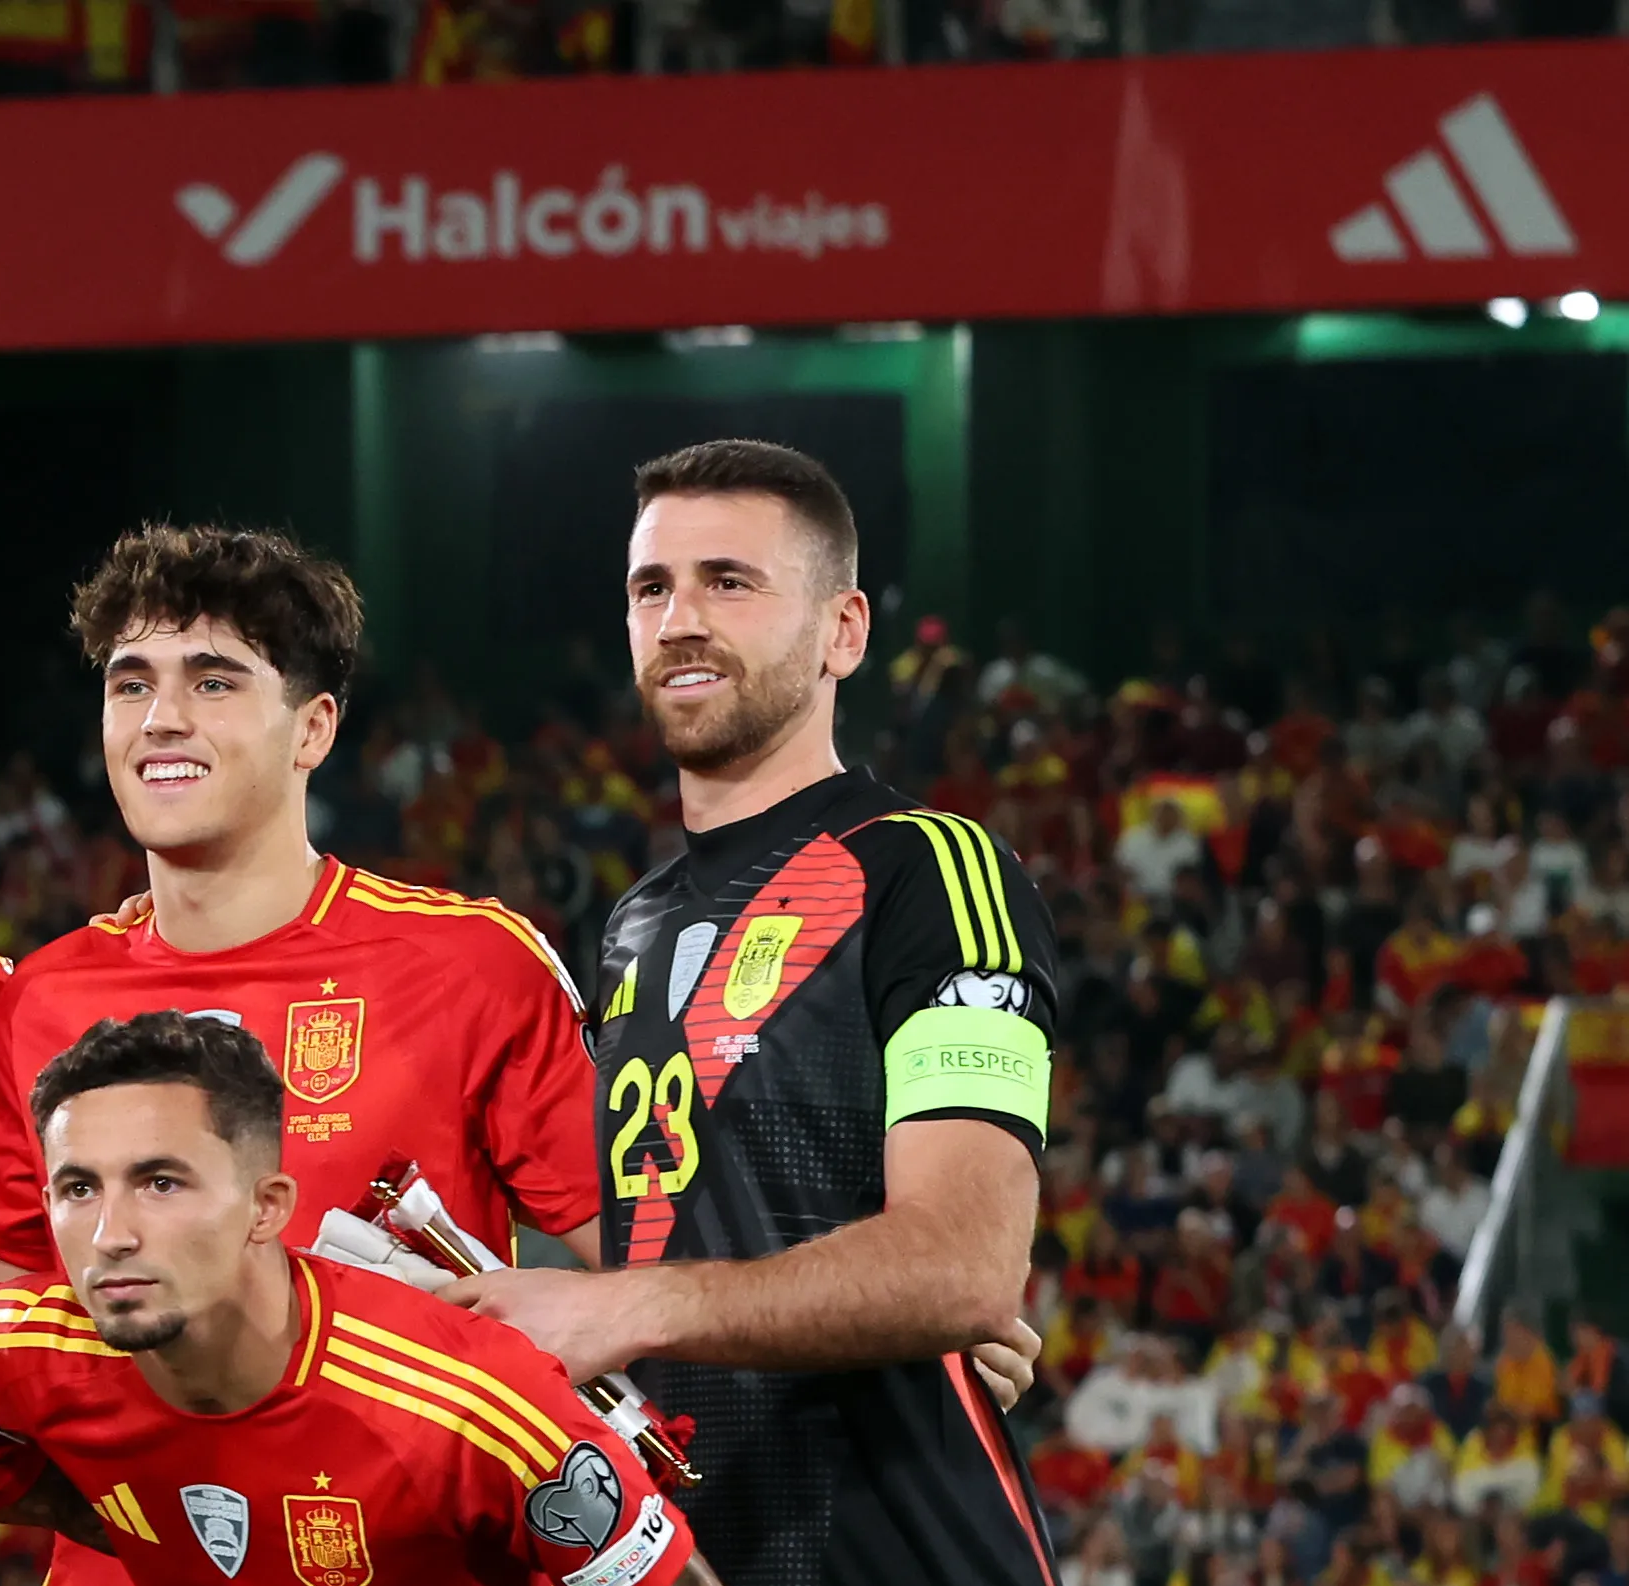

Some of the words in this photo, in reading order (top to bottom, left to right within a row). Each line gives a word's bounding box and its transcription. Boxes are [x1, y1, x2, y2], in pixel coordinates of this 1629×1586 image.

[354, 165, 707, 264] Halcón
[718, 194, 889, 253] viajes
[940, 1050, 1034, 1082] RESPECT
[608, 1051, 701, 1200] 23
